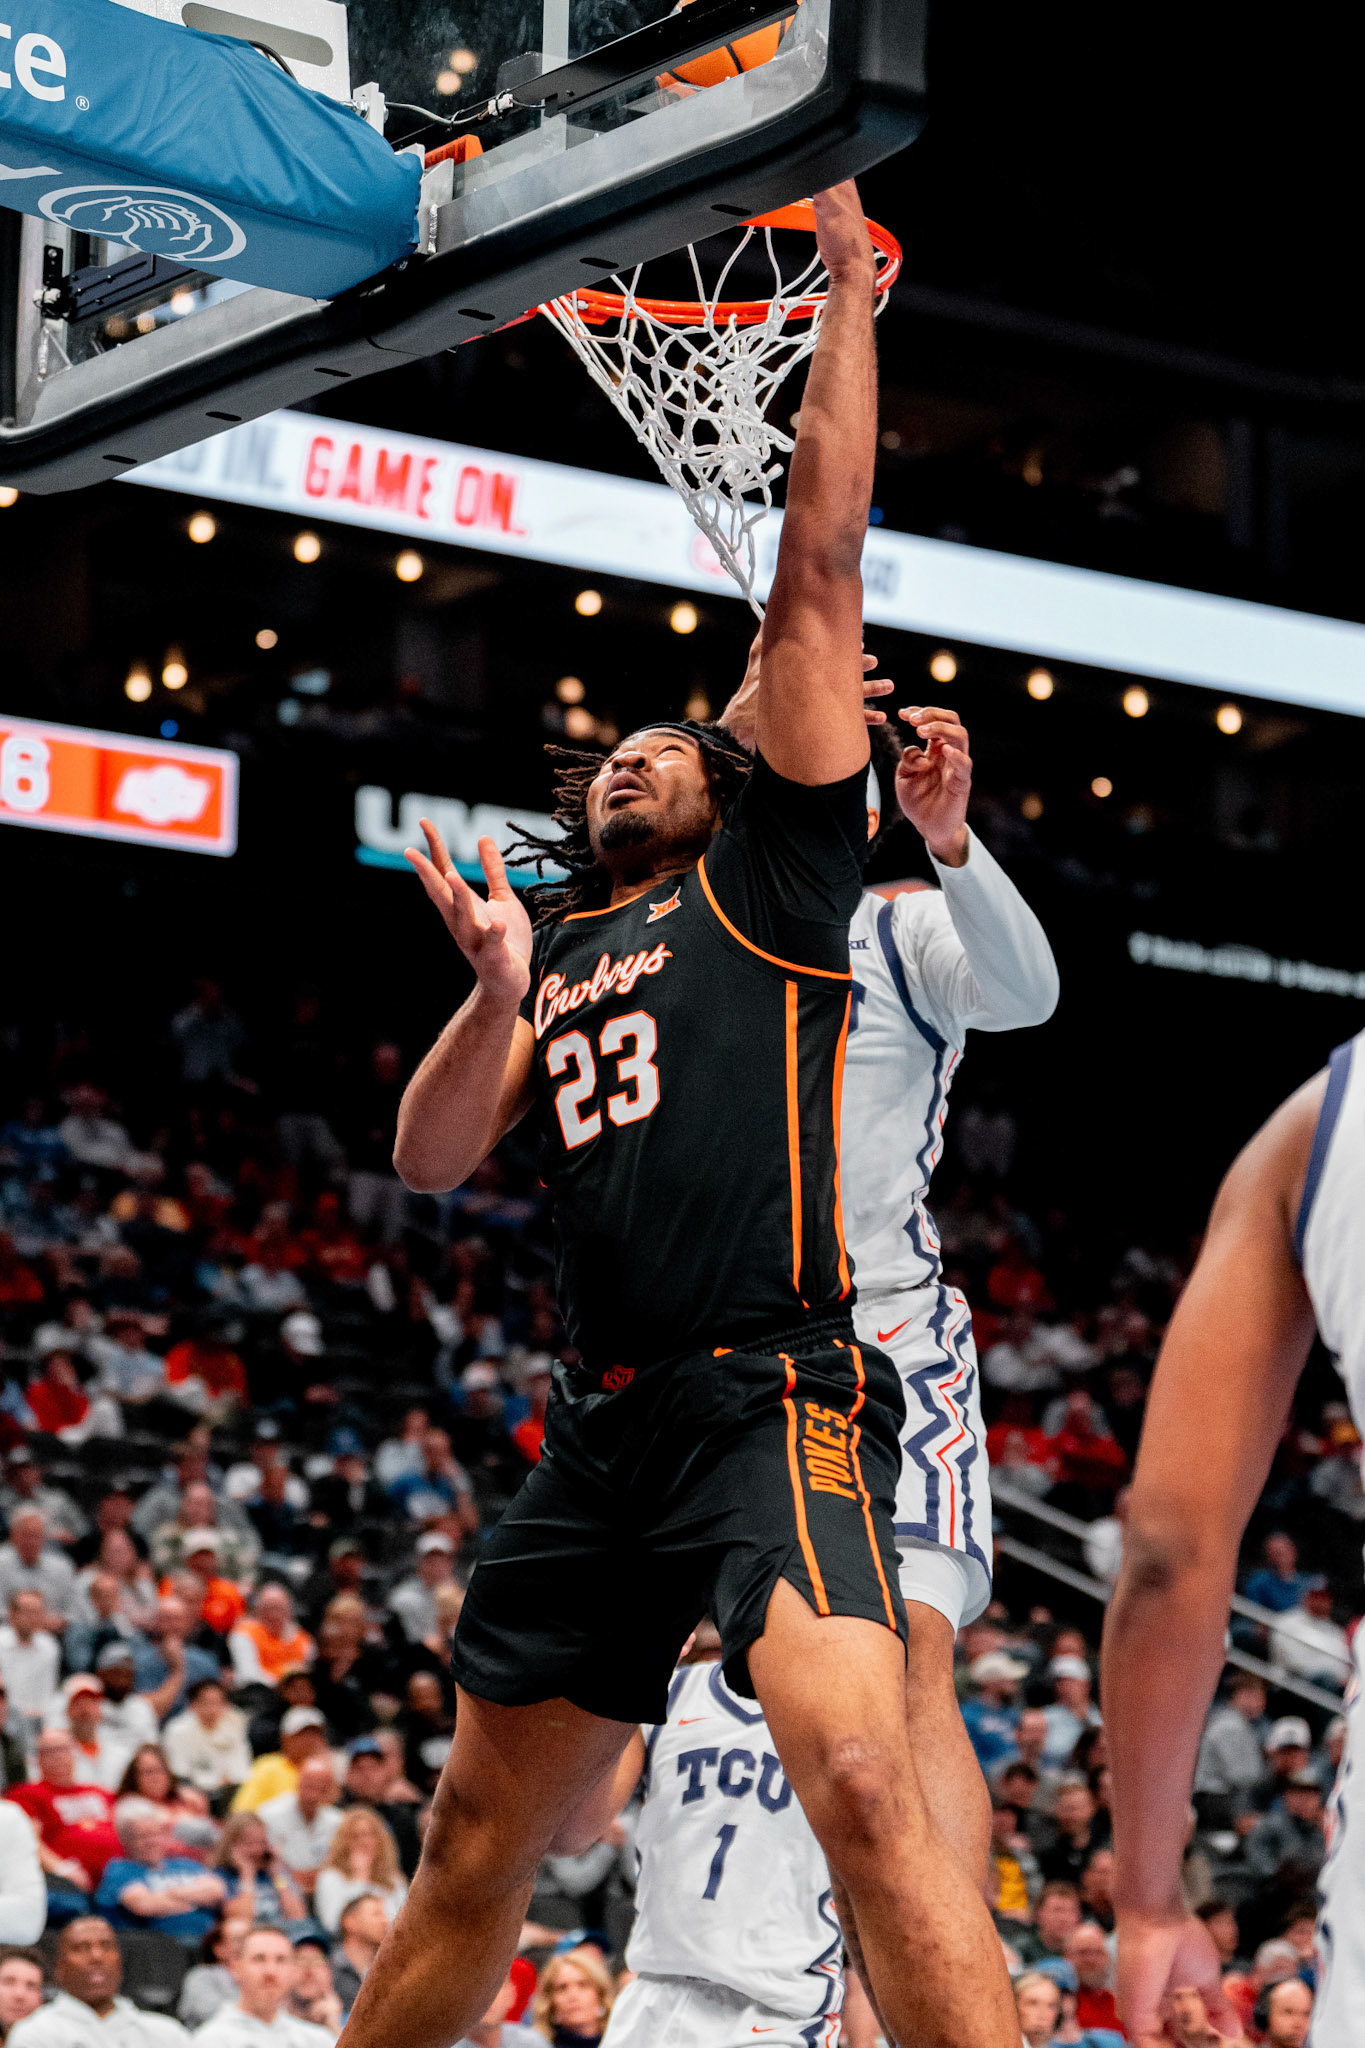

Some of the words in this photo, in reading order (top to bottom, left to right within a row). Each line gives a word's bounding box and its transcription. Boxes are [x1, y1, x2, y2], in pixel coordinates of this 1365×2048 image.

[303, 435, 438, 520] GAME
[534, 943, 673, 1040] Cowboys
[545, 1009, 661, 1150] 23
[802, 1402, 857, 1501] POKES
[676, 1746, 794, 1814] TCU
[702, 1823, 738, 1901] 1
